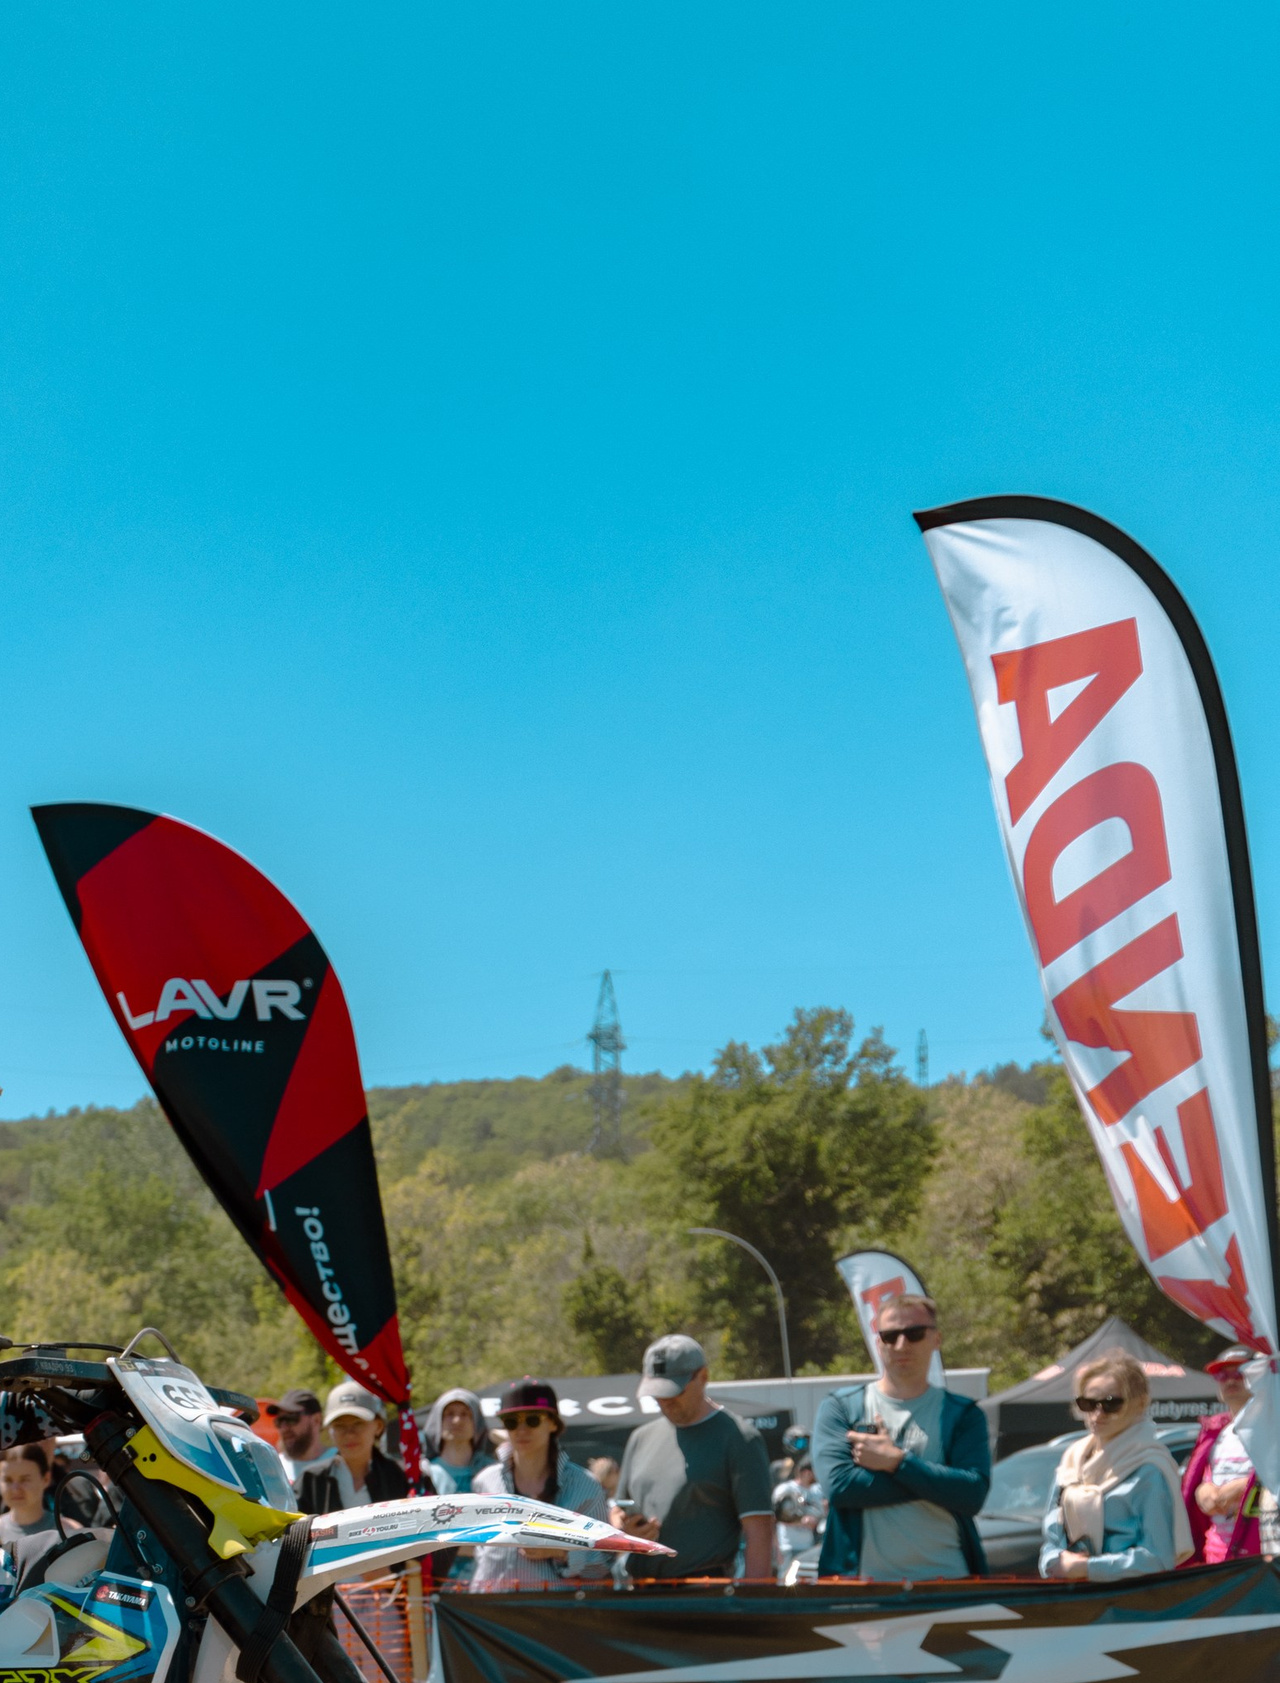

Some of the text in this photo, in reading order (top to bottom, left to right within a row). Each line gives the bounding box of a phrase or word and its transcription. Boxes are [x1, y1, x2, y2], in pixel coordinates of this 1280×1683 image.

[166, 1036, 265, 1053] MOTOLINE
[475, 1502, 524, 1515] VELOCITY
[109, 1591, 146, 1606] TAKAYAMA
